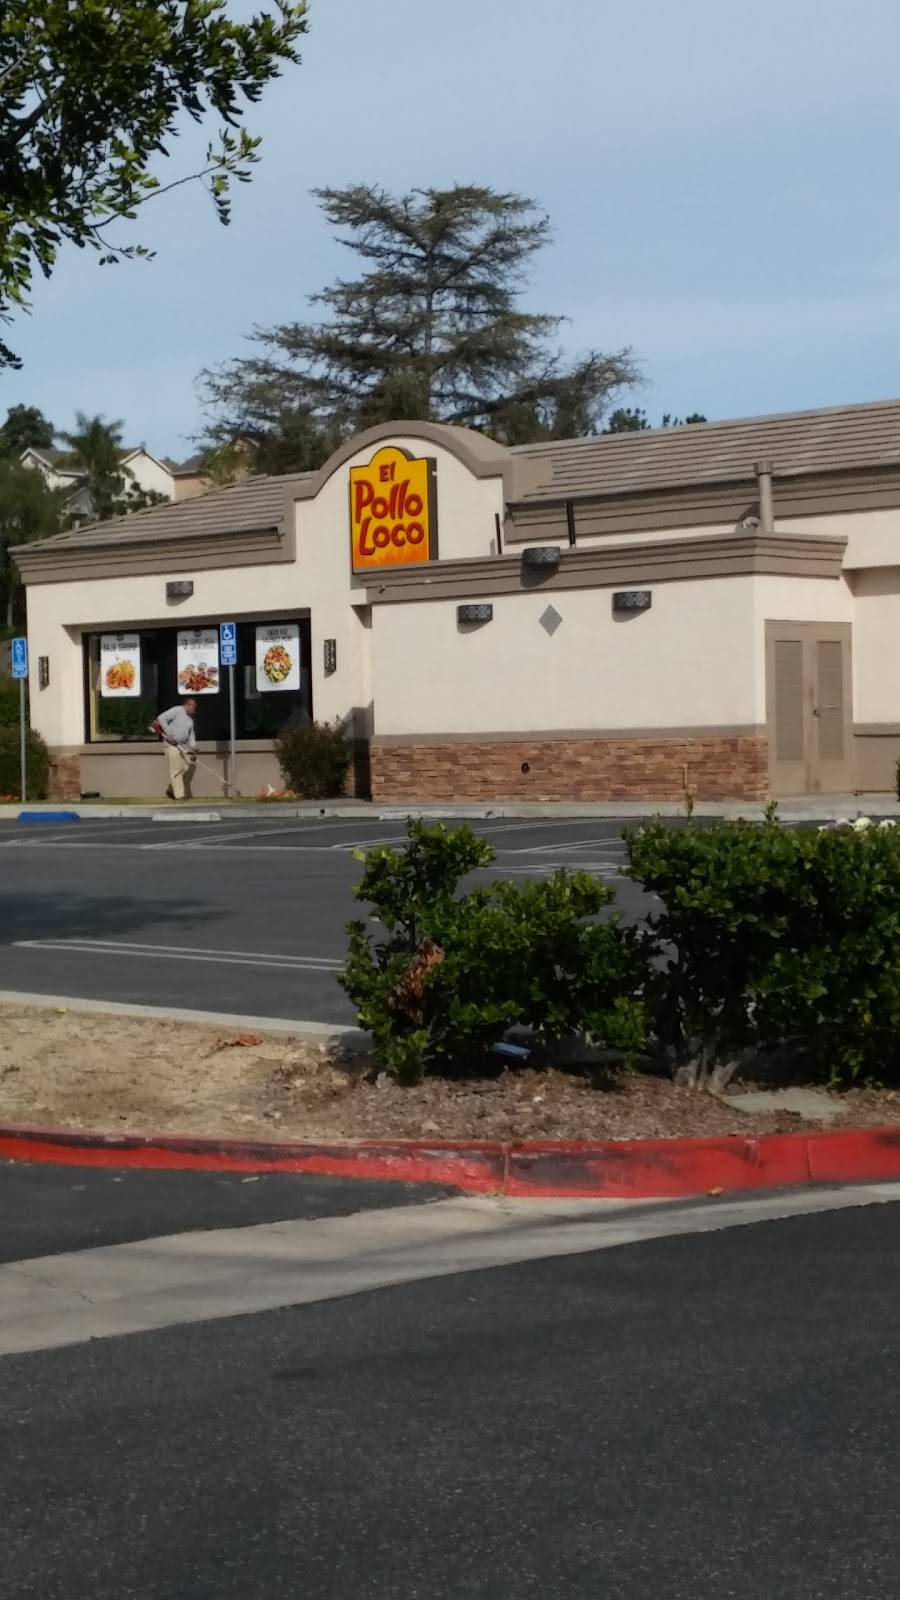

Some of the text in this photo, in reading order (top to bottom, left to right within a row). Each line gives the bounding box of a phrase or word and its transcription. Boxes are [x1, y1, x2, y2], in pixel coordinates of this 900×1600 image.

[379, 462, 396, 482] El
[353, 479, 423, 524] Pollo
[359, 517, 424, 556] Loco
